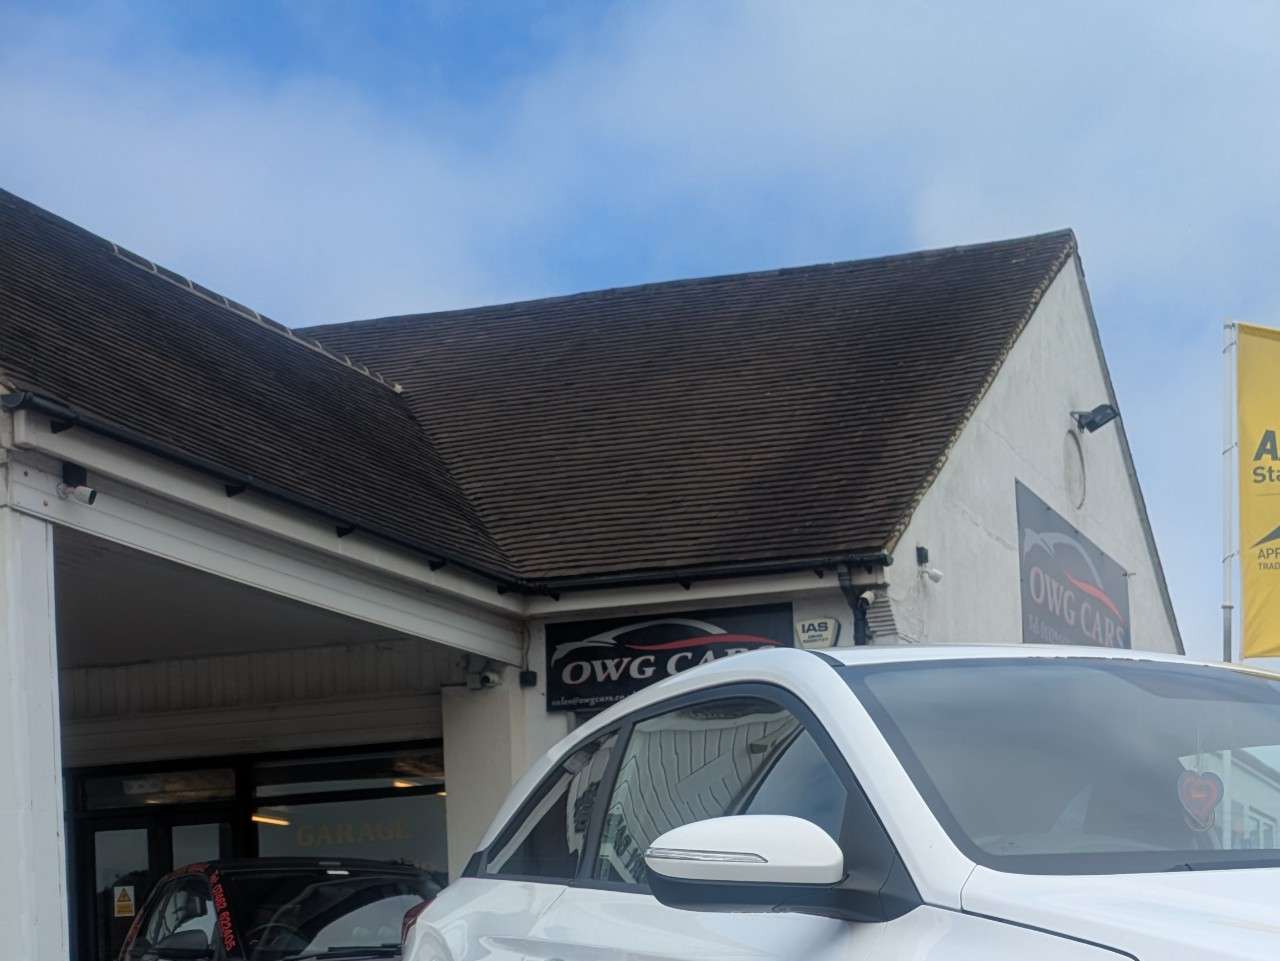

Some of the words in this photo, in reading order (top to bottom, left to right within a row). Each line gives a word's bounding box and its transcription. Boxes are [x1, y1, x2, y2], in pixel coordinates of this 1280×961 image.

[1030, 566, 1075, 625] OWG
[801, 621, 828, 633] IAS
[562, 655, 656, 685] OWG
